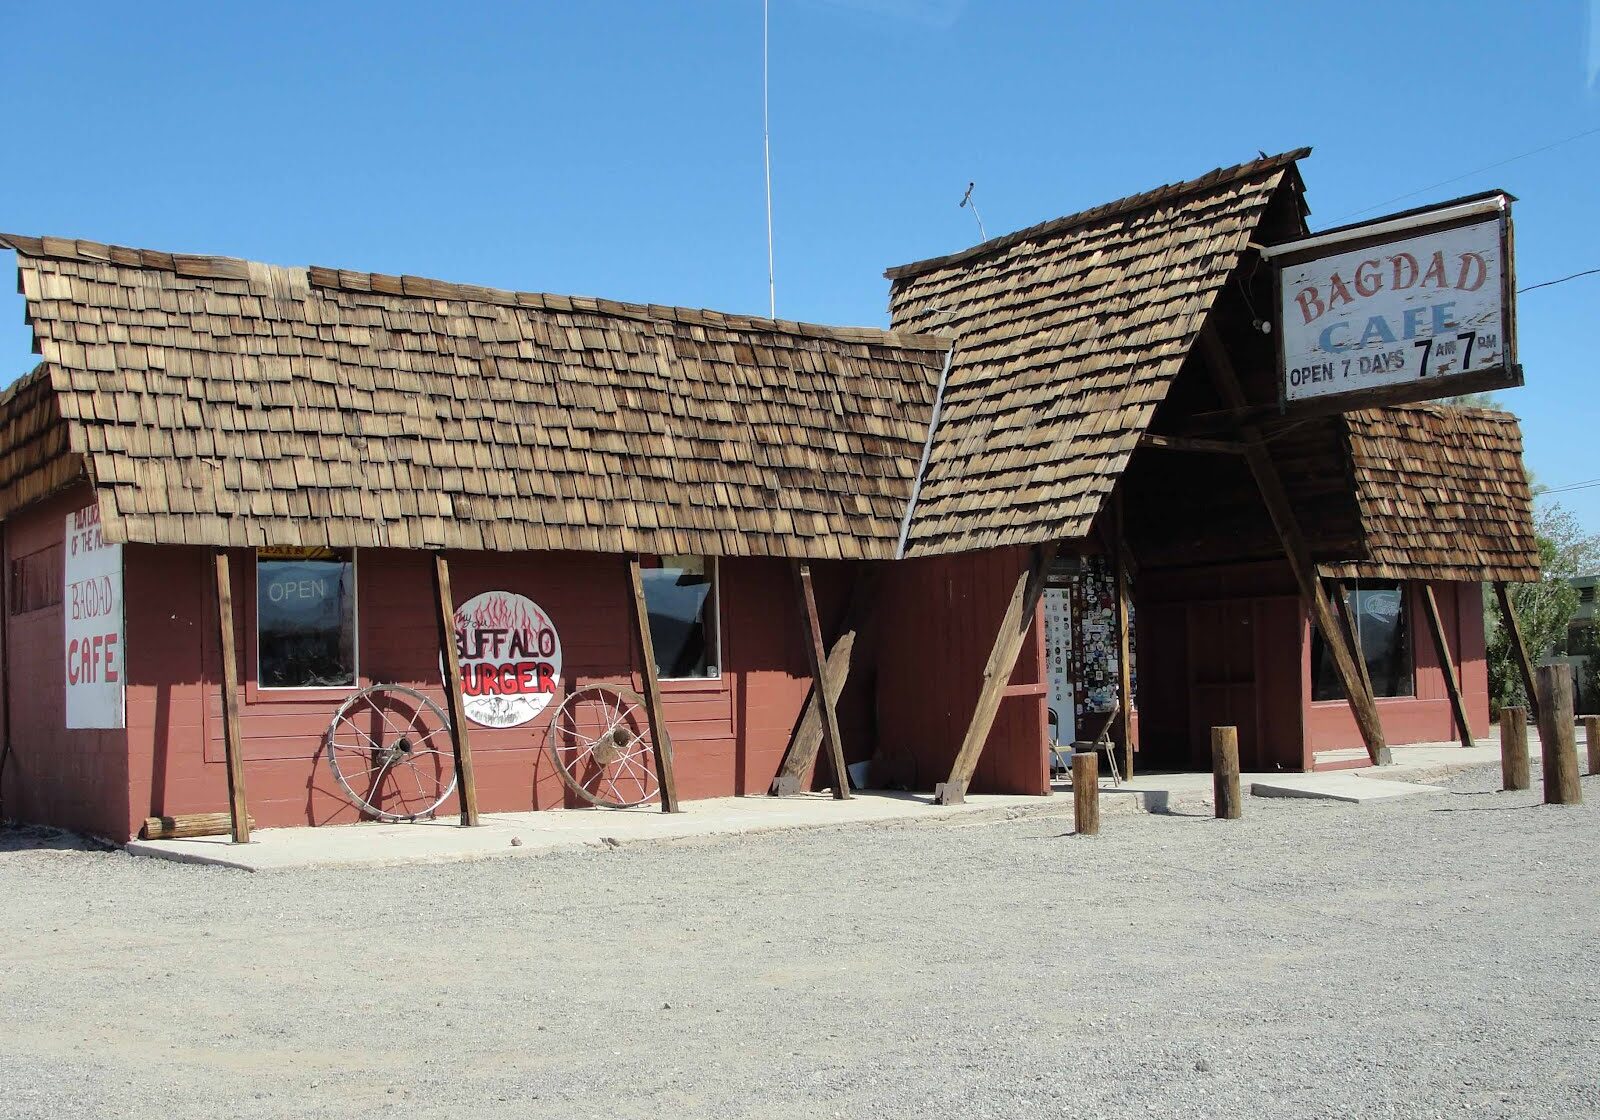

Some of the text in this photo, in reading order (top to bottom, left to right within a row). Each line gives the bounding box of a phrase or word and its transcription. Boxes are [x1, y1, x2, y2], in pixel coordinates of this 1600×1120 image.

[1294, 250, 1487, 326] BAGDAD
[1318, 301, 1458, 353] CAFE
[1290, 331, 1497, 386] OPEN 7 DAYS 7 AM 7 PM
[81, 529, 93, 553] THE
[71, 575, 113, 621] BAGDAD
[268, 578, 325, 602] OPEN
[68, 632, 119, 686] CAFE
